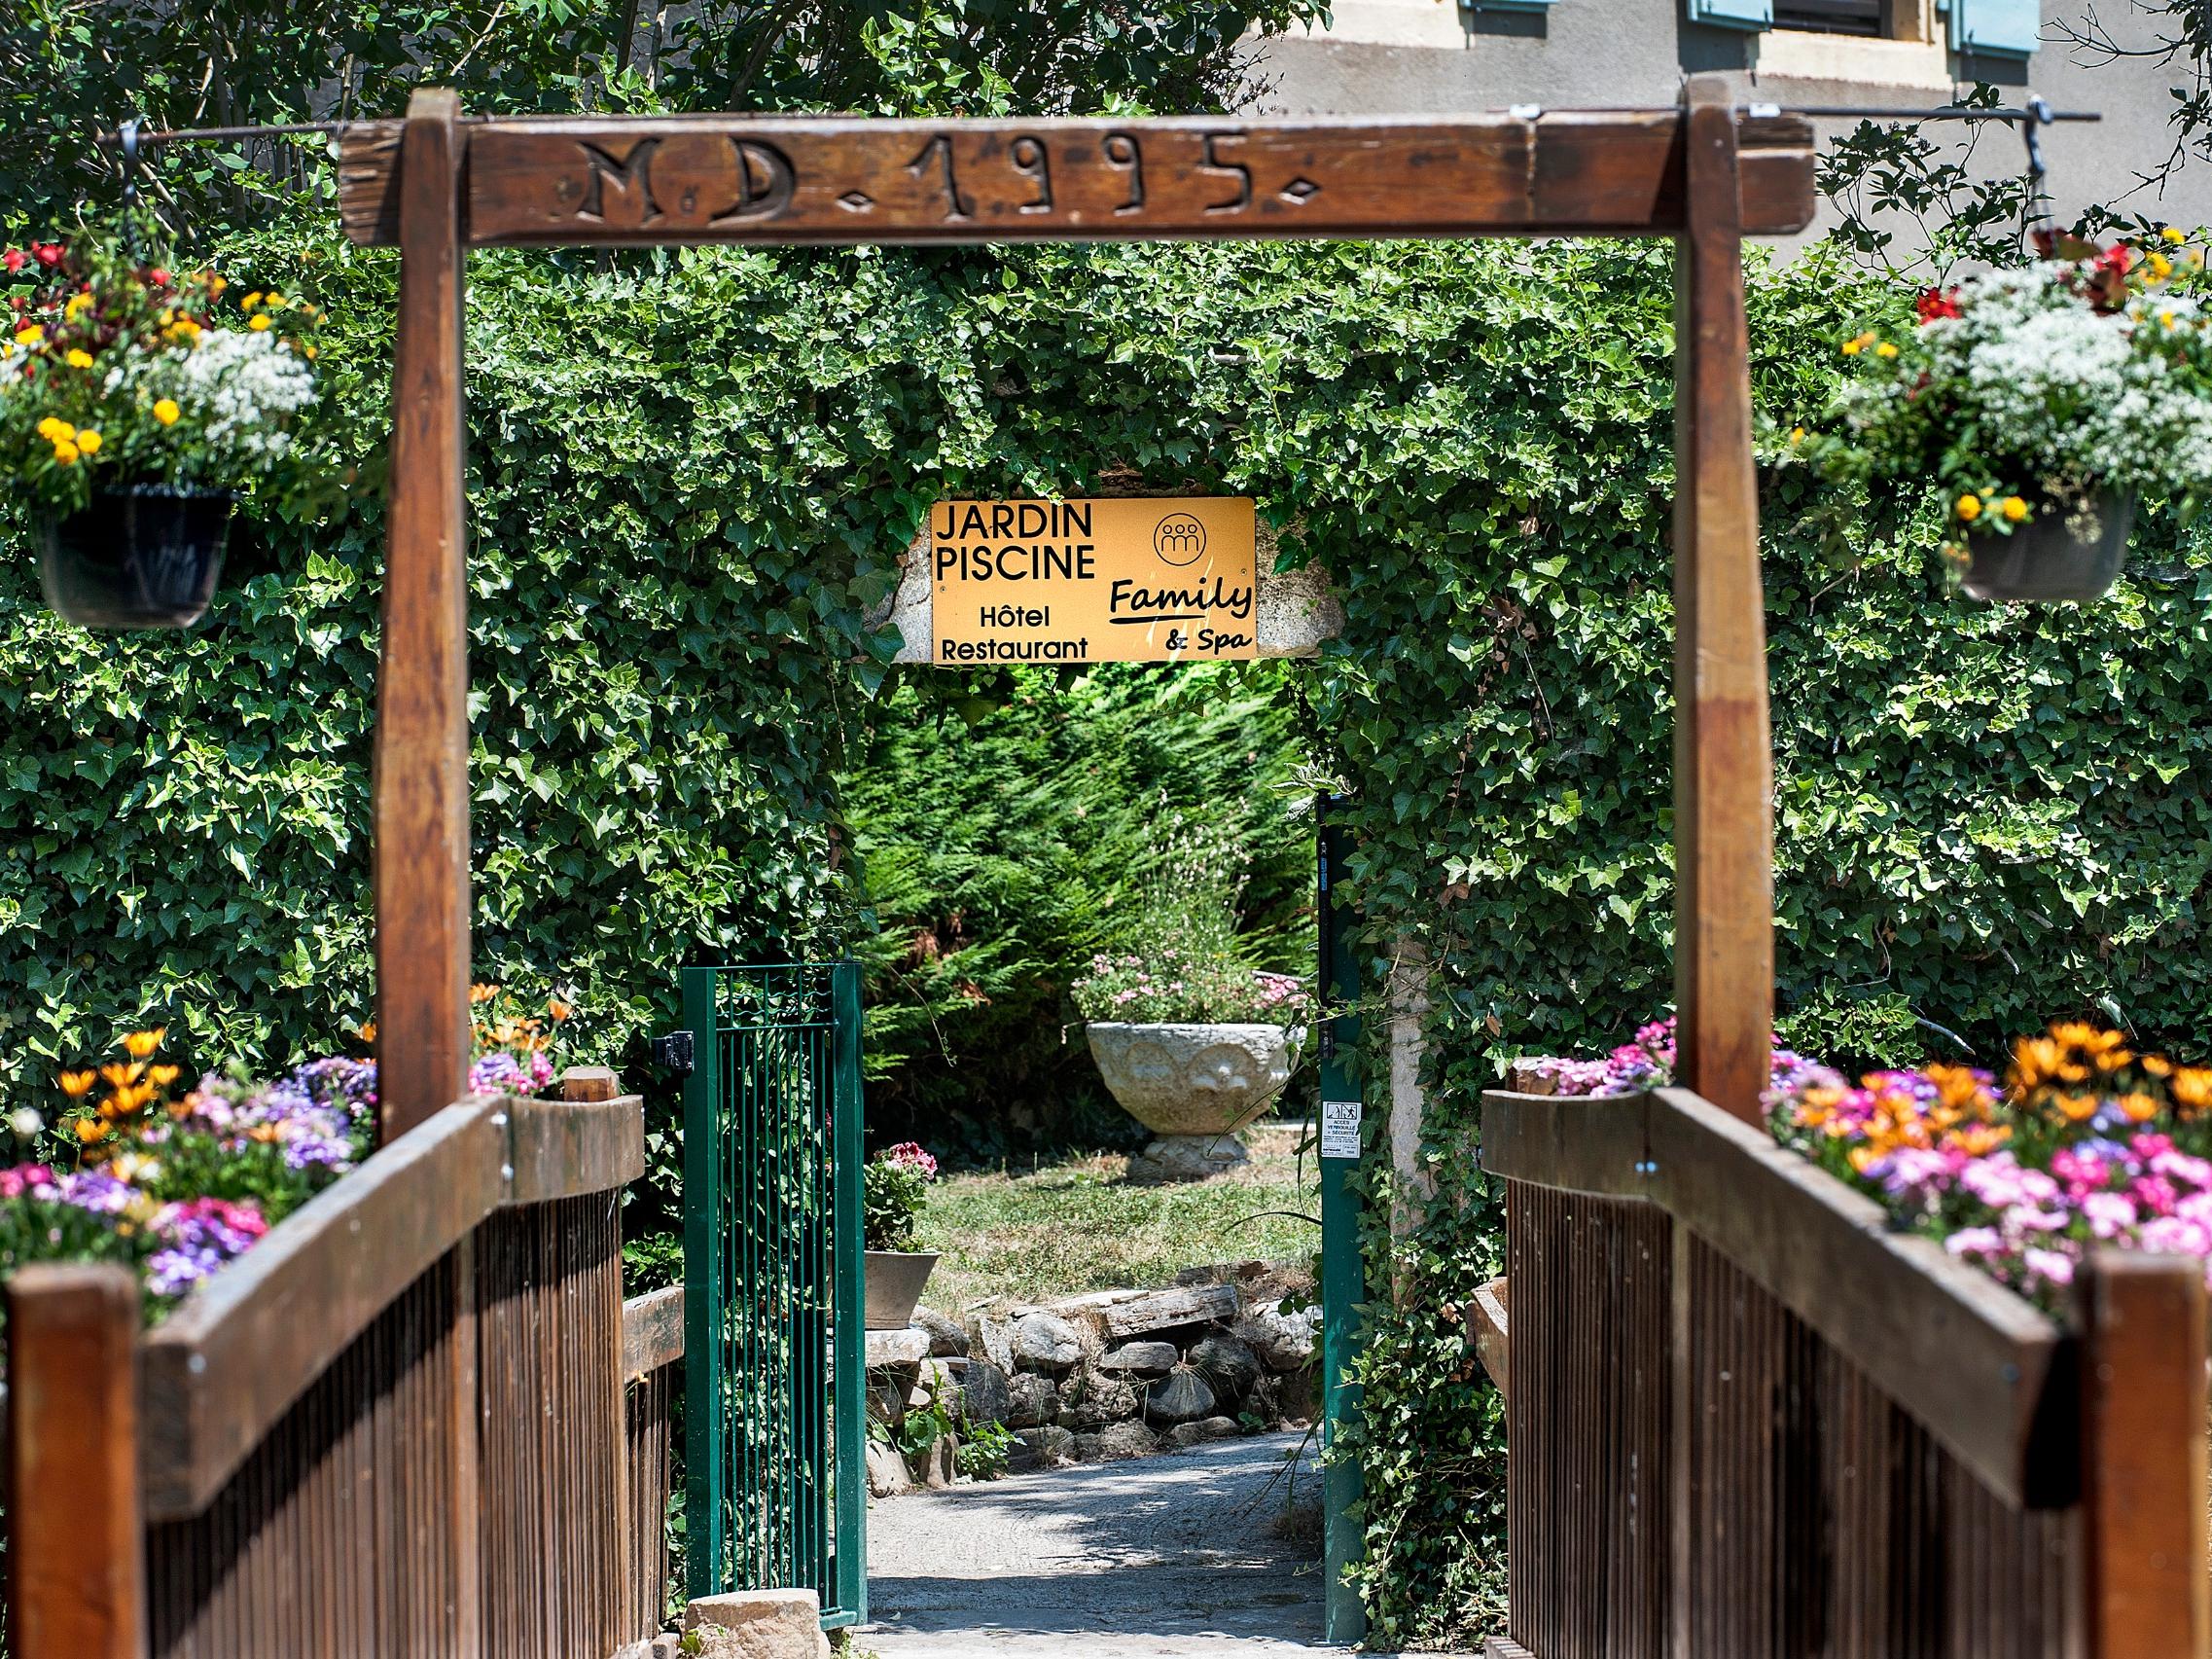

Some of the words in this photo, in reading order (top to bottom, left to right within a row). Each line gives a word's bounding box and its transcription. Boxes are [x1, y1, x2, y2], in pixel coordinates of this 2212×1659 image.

[936, 502, 1092, 540] JARDIN
[936, 545, 1095, 581] PISCINE
[1109, 576, 1252, 620] Family
[980, 604, 1050, 628] Hôtel
[942, 636, 1088, 661] Restaurant
[1165, 629, 1189, 651] &
[1197, 629, 1252, 656] Spa
